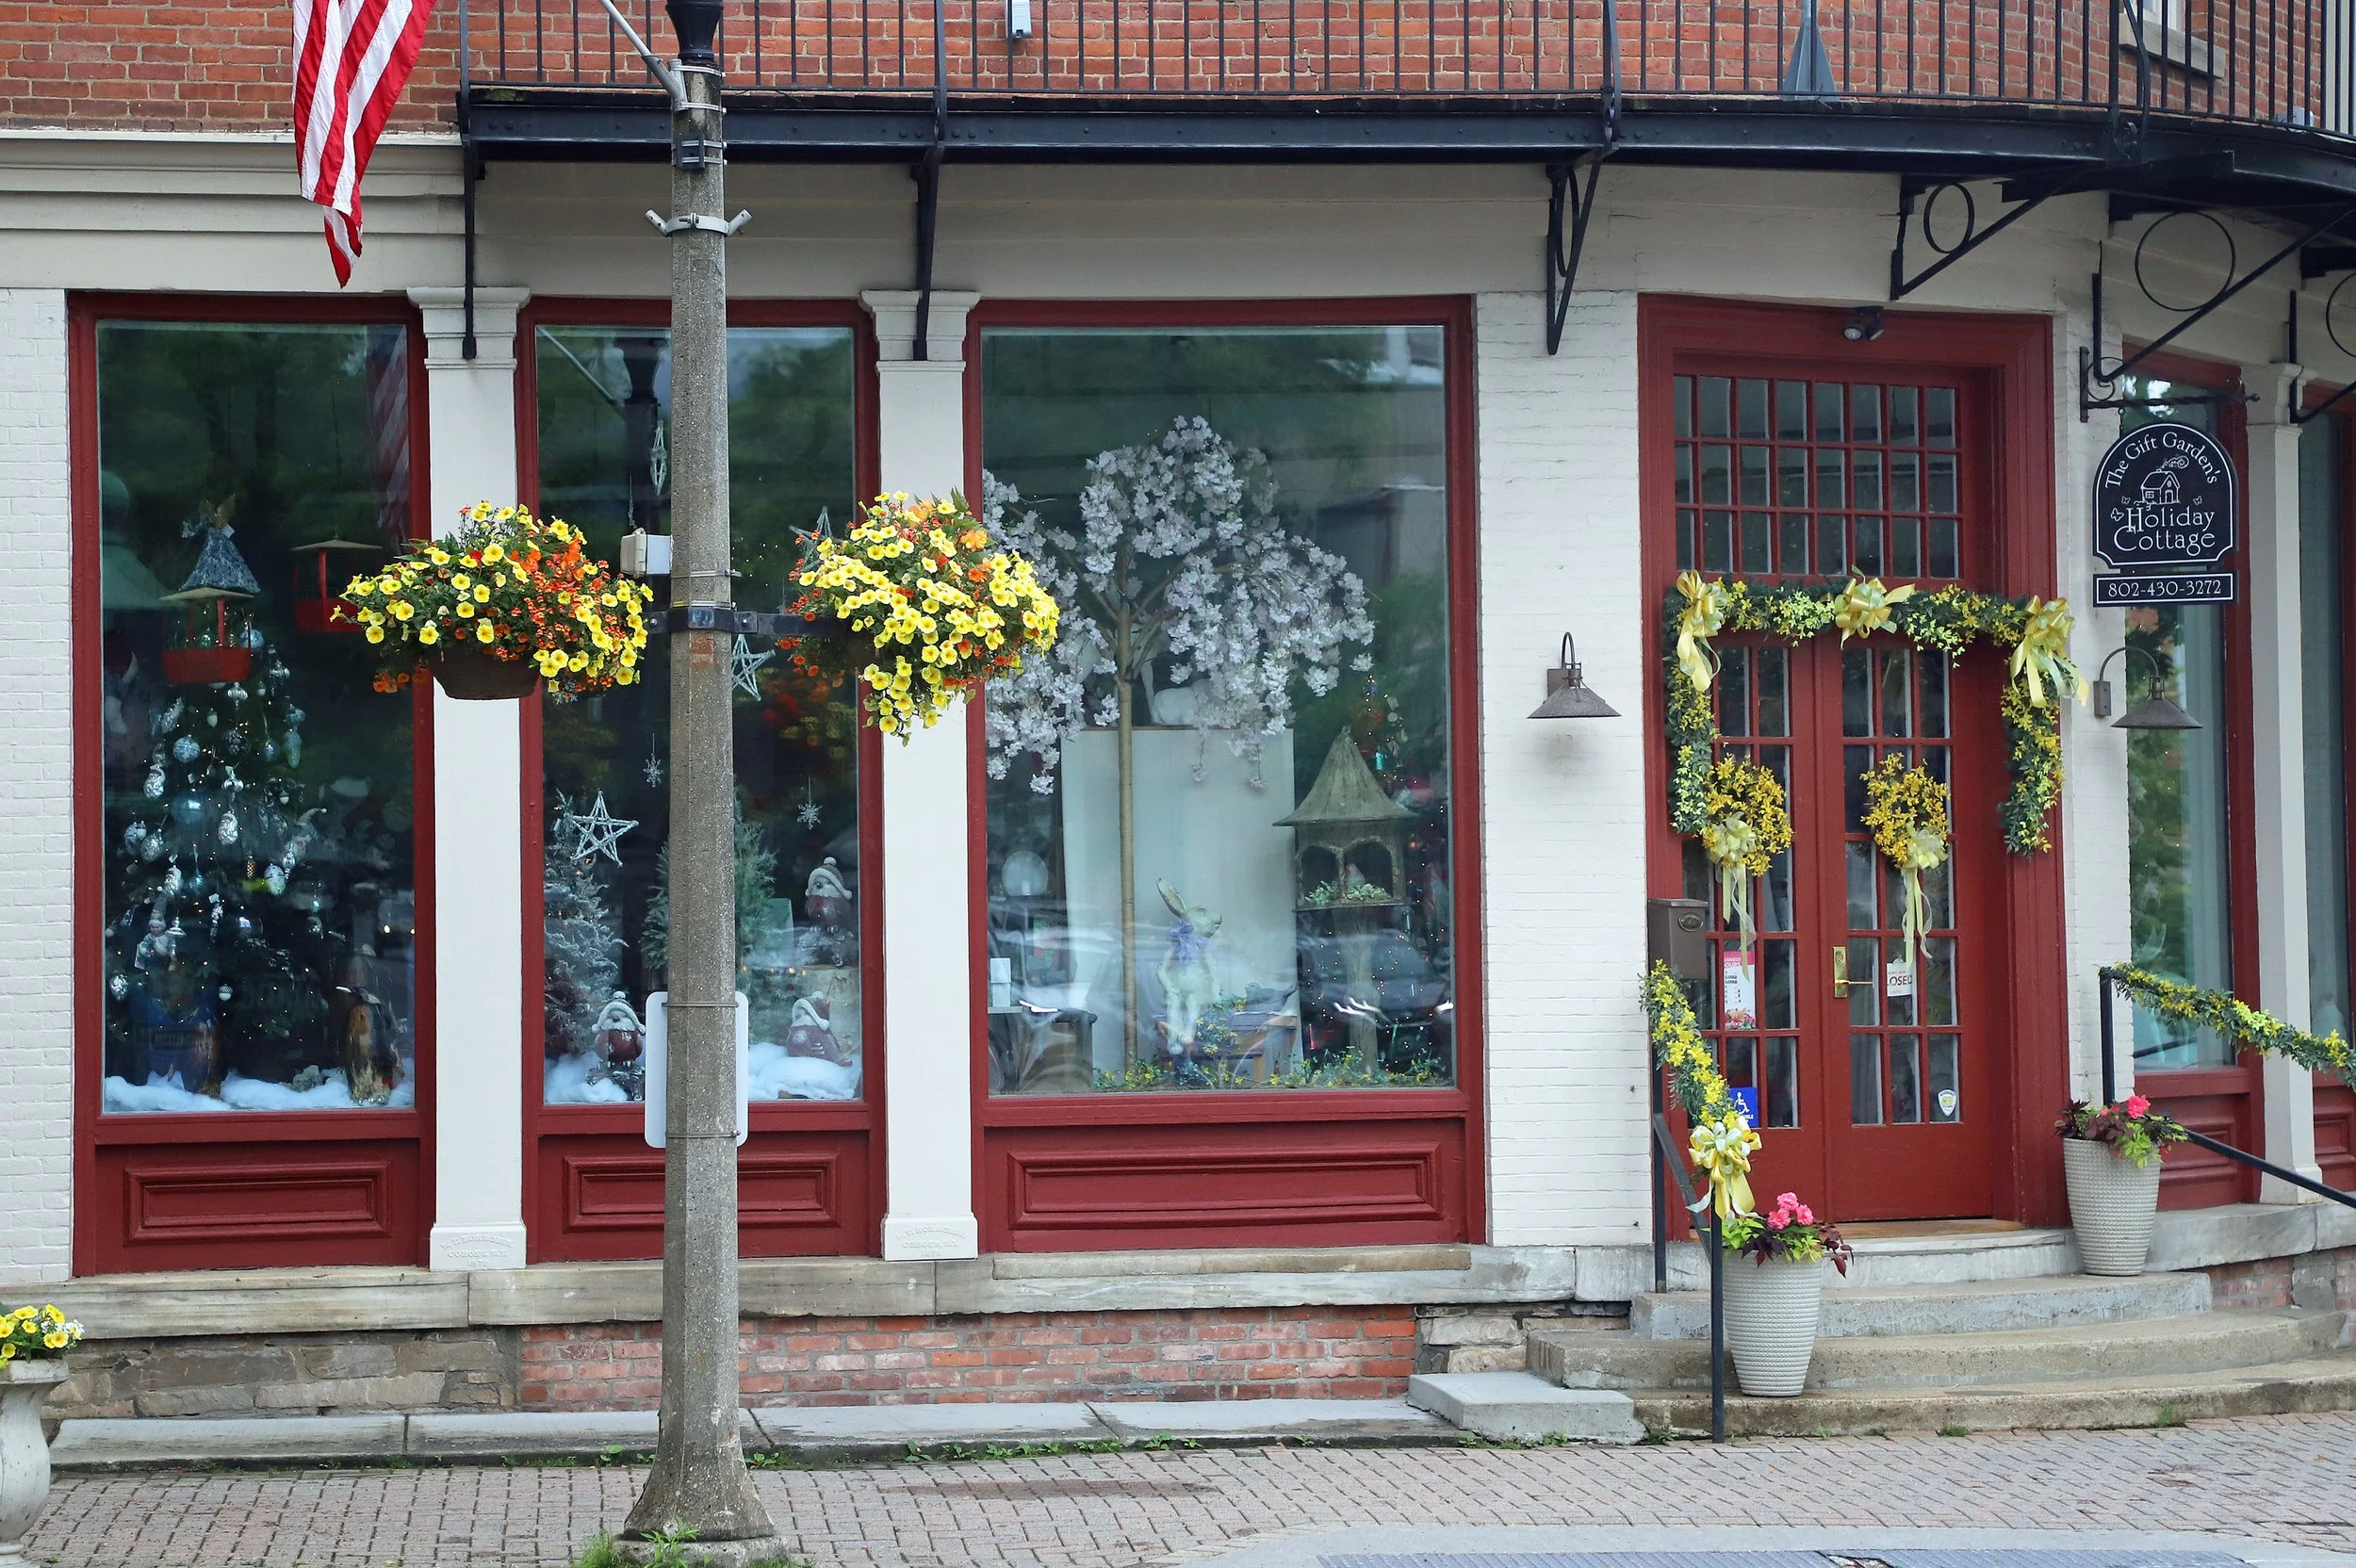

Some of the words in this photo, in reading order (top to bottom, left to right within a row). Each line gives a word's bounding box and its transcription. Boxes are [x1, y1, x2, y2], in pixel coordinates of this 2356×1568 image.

[2105, 460, 2129, 489] The
[2125, 433, 2157, 460] Gift
[2163, 432, 2221, 484] Garden's
[2126, 506, 2215, 531] Holiday
[2114, 525, 2216, 556] Cottage
[2108, 580, 2221, 597] 802-430-3272
[1887, 975, 1912, 987] OSED
